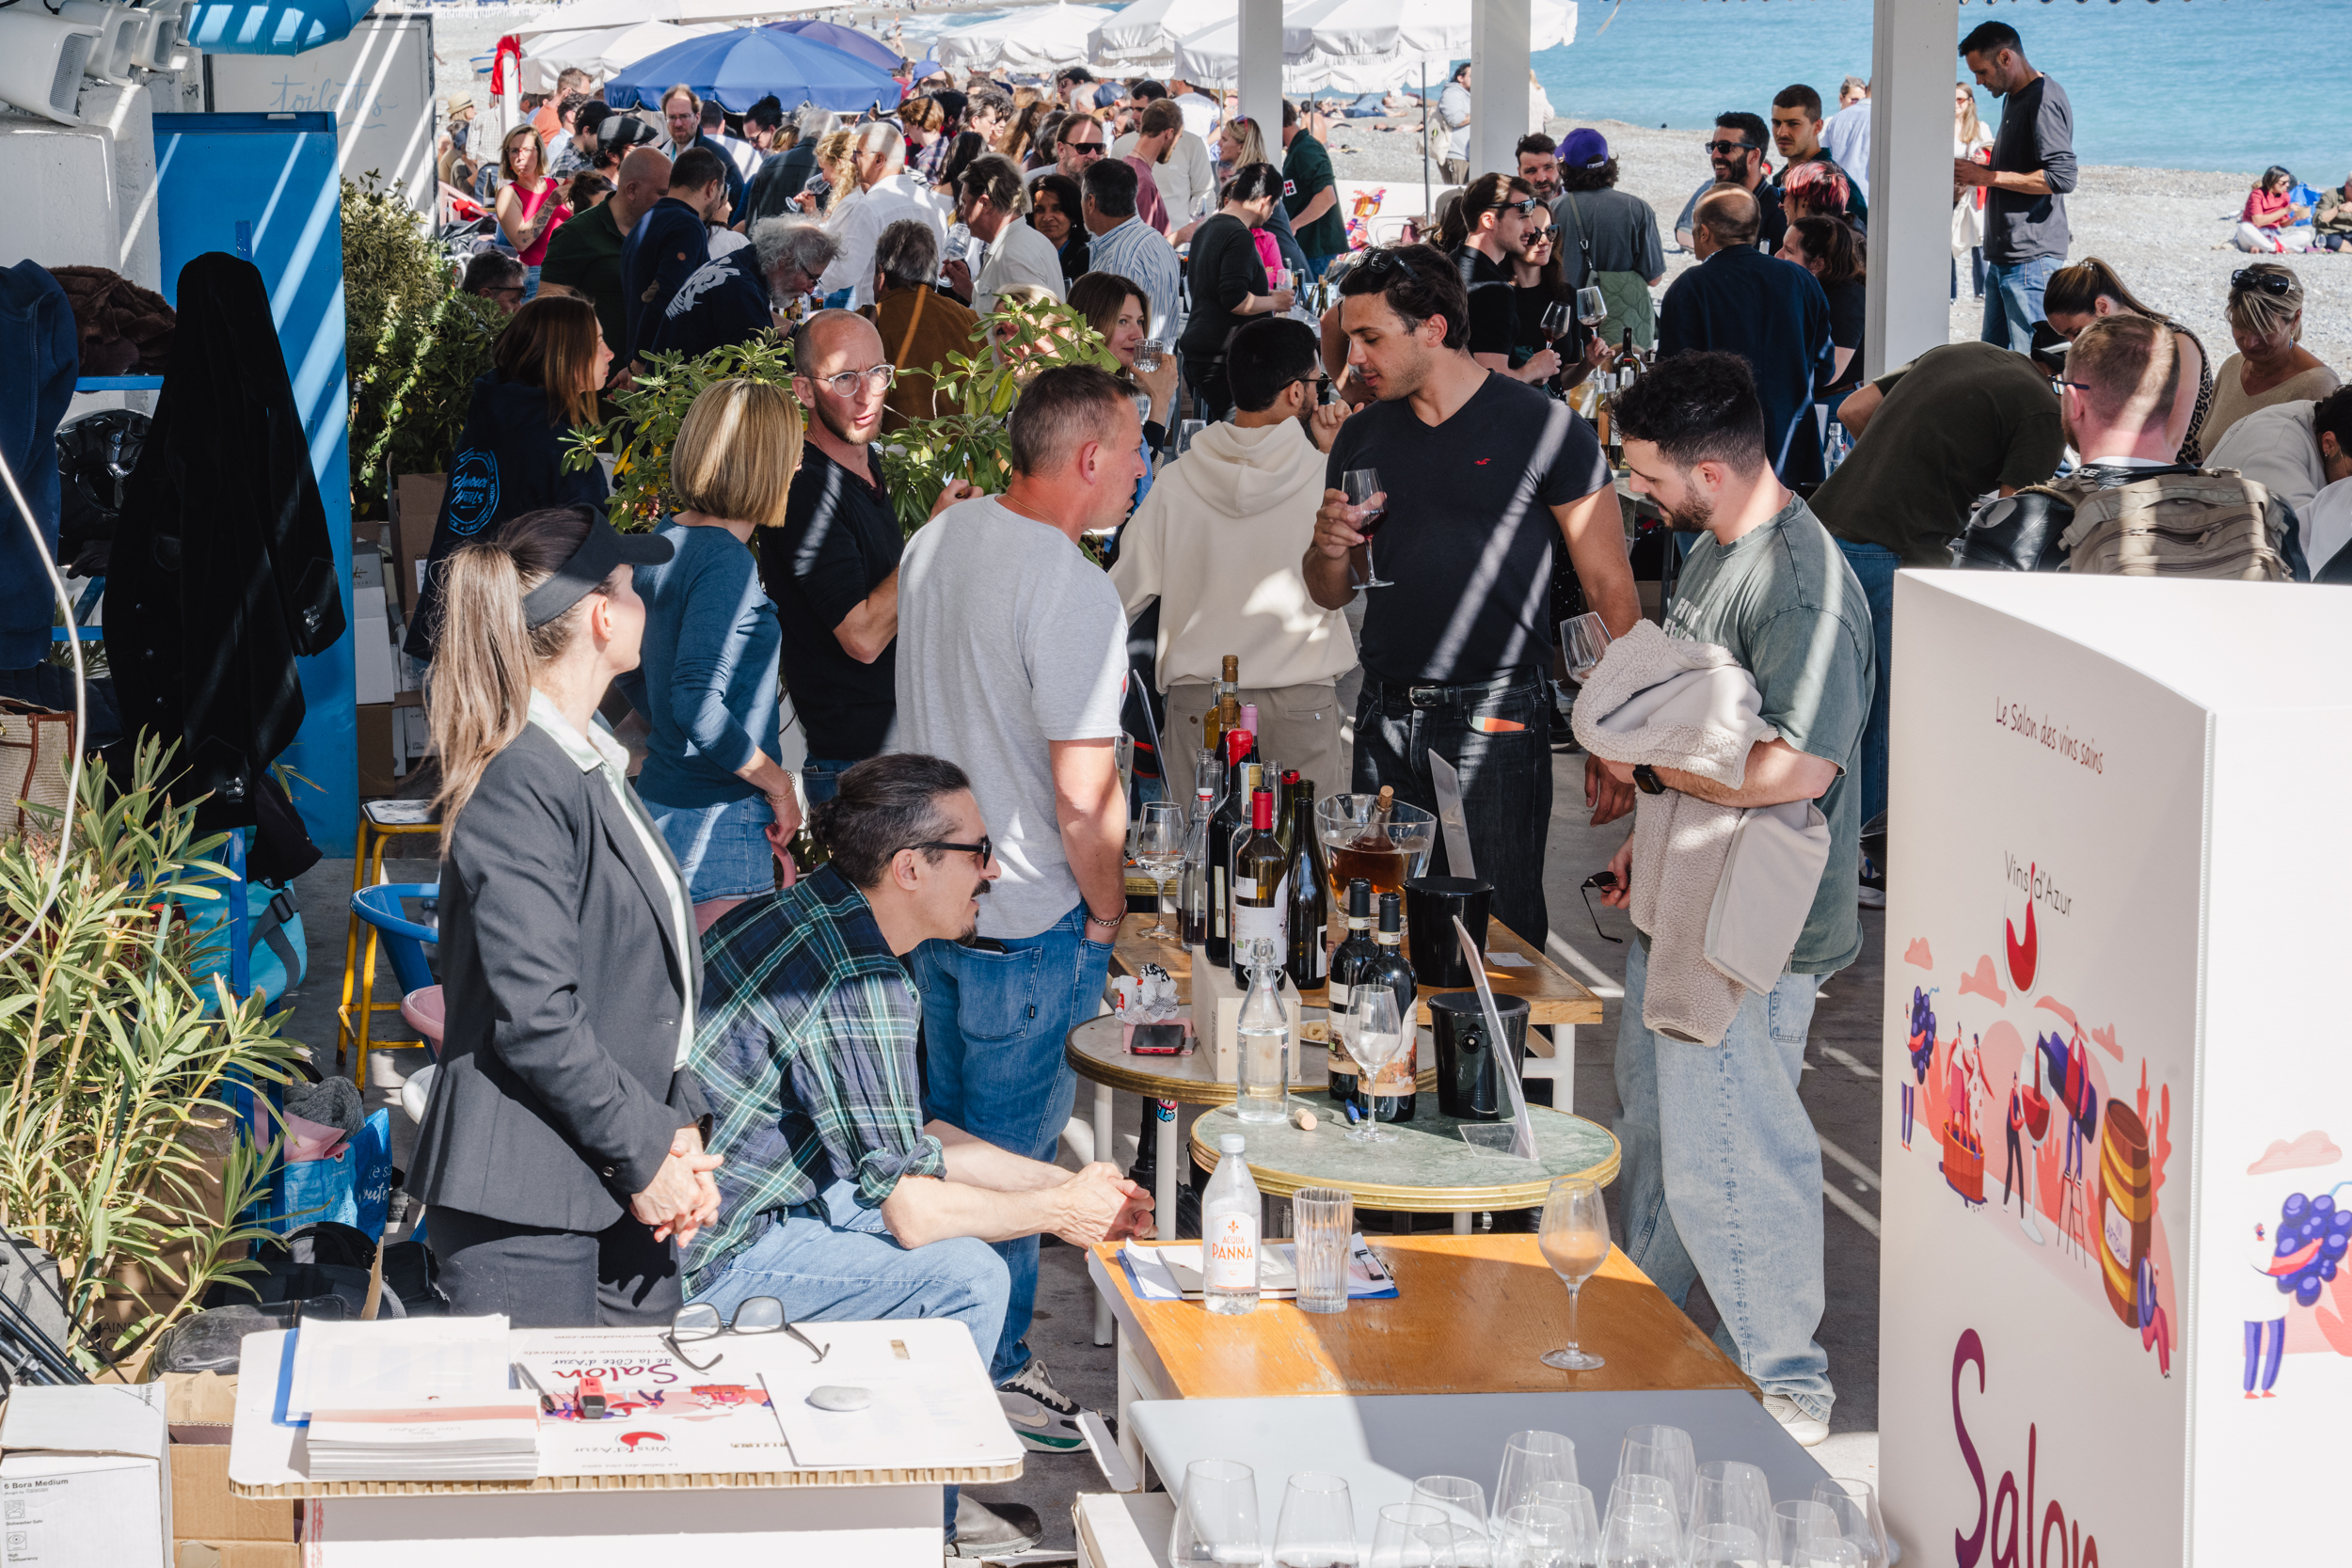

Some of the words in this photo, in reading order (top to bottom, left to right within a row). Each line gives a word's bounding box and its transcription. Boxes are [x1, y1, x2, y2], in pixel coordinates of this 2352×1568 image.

[269, 73, 398, 117] toilettes
[1995, 696, 2008, 726] Le
[2010, 704, 2038, 739] Salon
[2040, 714, 2057, 750] des
[2059, 725, 2078, 761] vins
[2080, 737, 2104, 774] sains
[2005, 849, 2029, 893] Vins
[2033, 869, 2073, 918] d'Azur
[1222, 1236, 1246, 1245] ACQUA
[1212, 1243, 1253, 1261] PANNA
[602, 1357, 633, 1366] Côte
[551, 1364, 679, 1384] Salon
[1951, 1328, 2099, 1568] Salon
[35, 1479, 69, 1487] Medium
